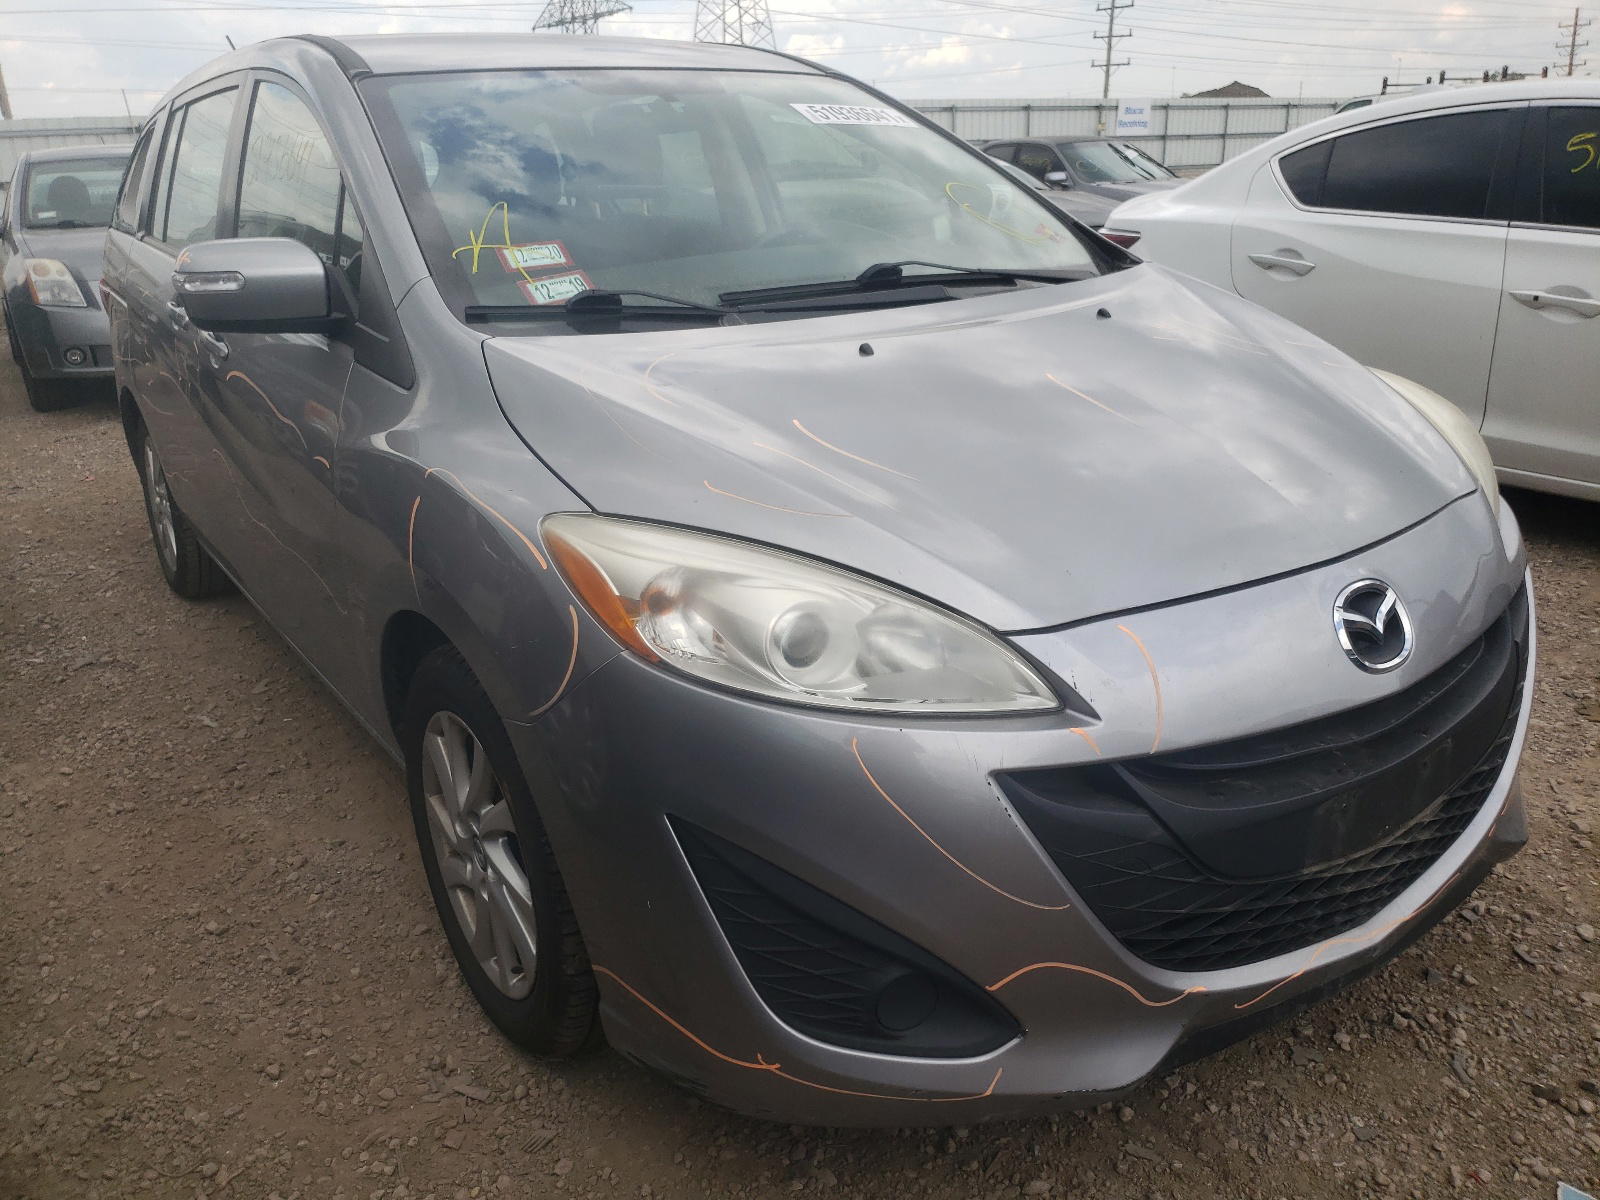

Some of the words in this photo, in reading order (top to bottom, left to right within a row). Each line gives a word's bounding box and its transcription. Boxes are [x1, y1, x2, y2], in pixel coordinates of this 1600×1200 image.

[1566, 132, 1600, 174] 5
[534, 283, 555, 301] 12
[568, 276, 588, 294] 19
